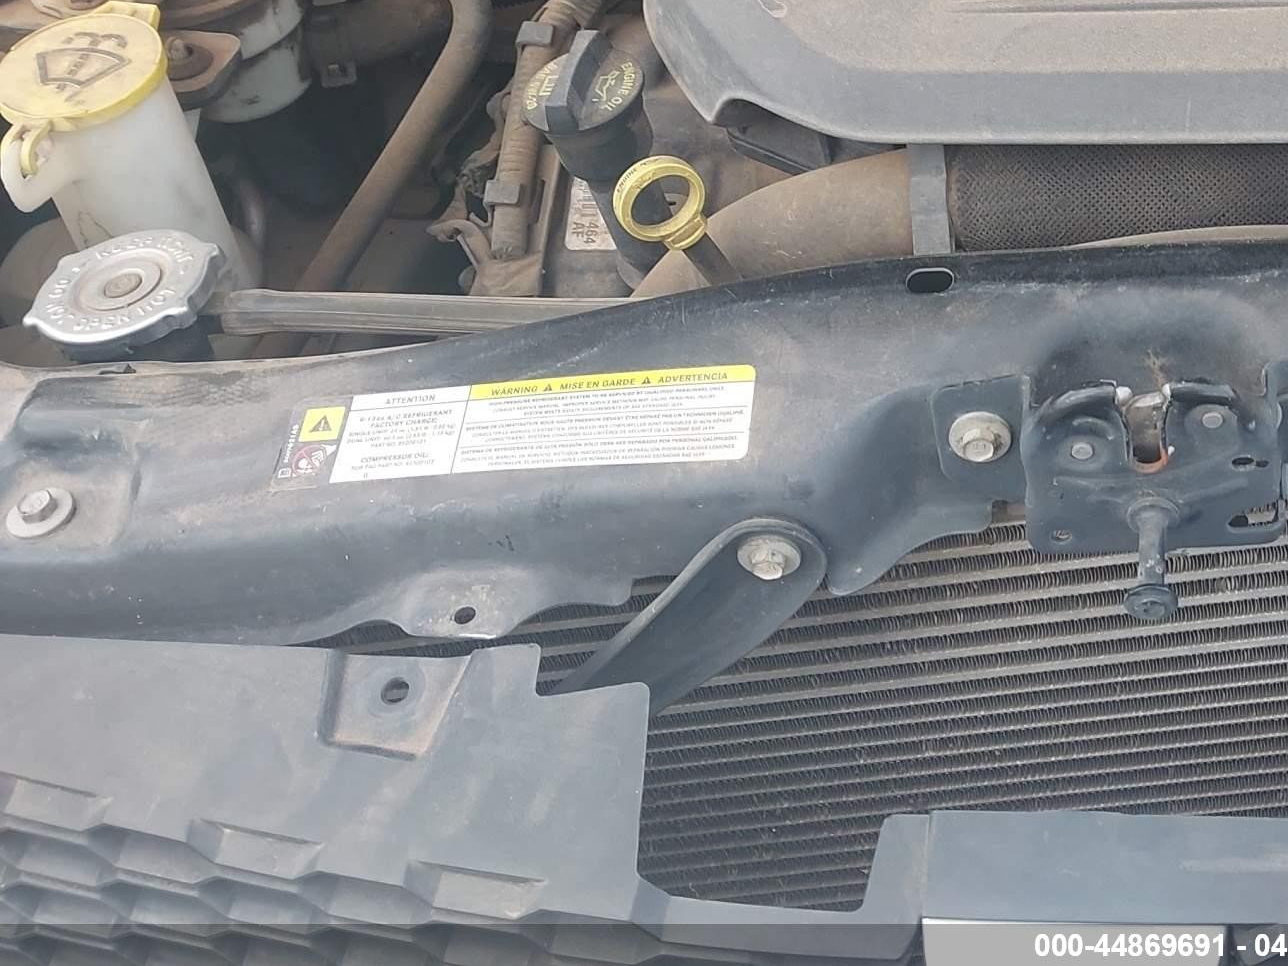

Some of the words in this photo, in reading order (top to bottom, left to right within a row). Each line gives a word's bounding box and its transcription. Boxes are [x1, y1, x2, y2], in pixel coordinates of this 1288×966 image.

[620, 61, 636, 95] ENGINE
[600, 96, 623, 111] OIL
[571, 221, 585, 238] AF
[583, 222, 600, 244] 464
[491, 385, 538, 396] WARNING
[559, 379, 586, 390] MISE
[586, 379, 600, 389] EN
[602, 377, 636, 388] GARDE
[658, 372, 728, 384] ADVERTENCIA
[385, 394, 436, 405] ATTENTION
[402, 409, 453, 420] REFRIGERANT
[370, 420, 404, 428] FACTORY
[360, 453, 414, 463] COMPRESSOR
